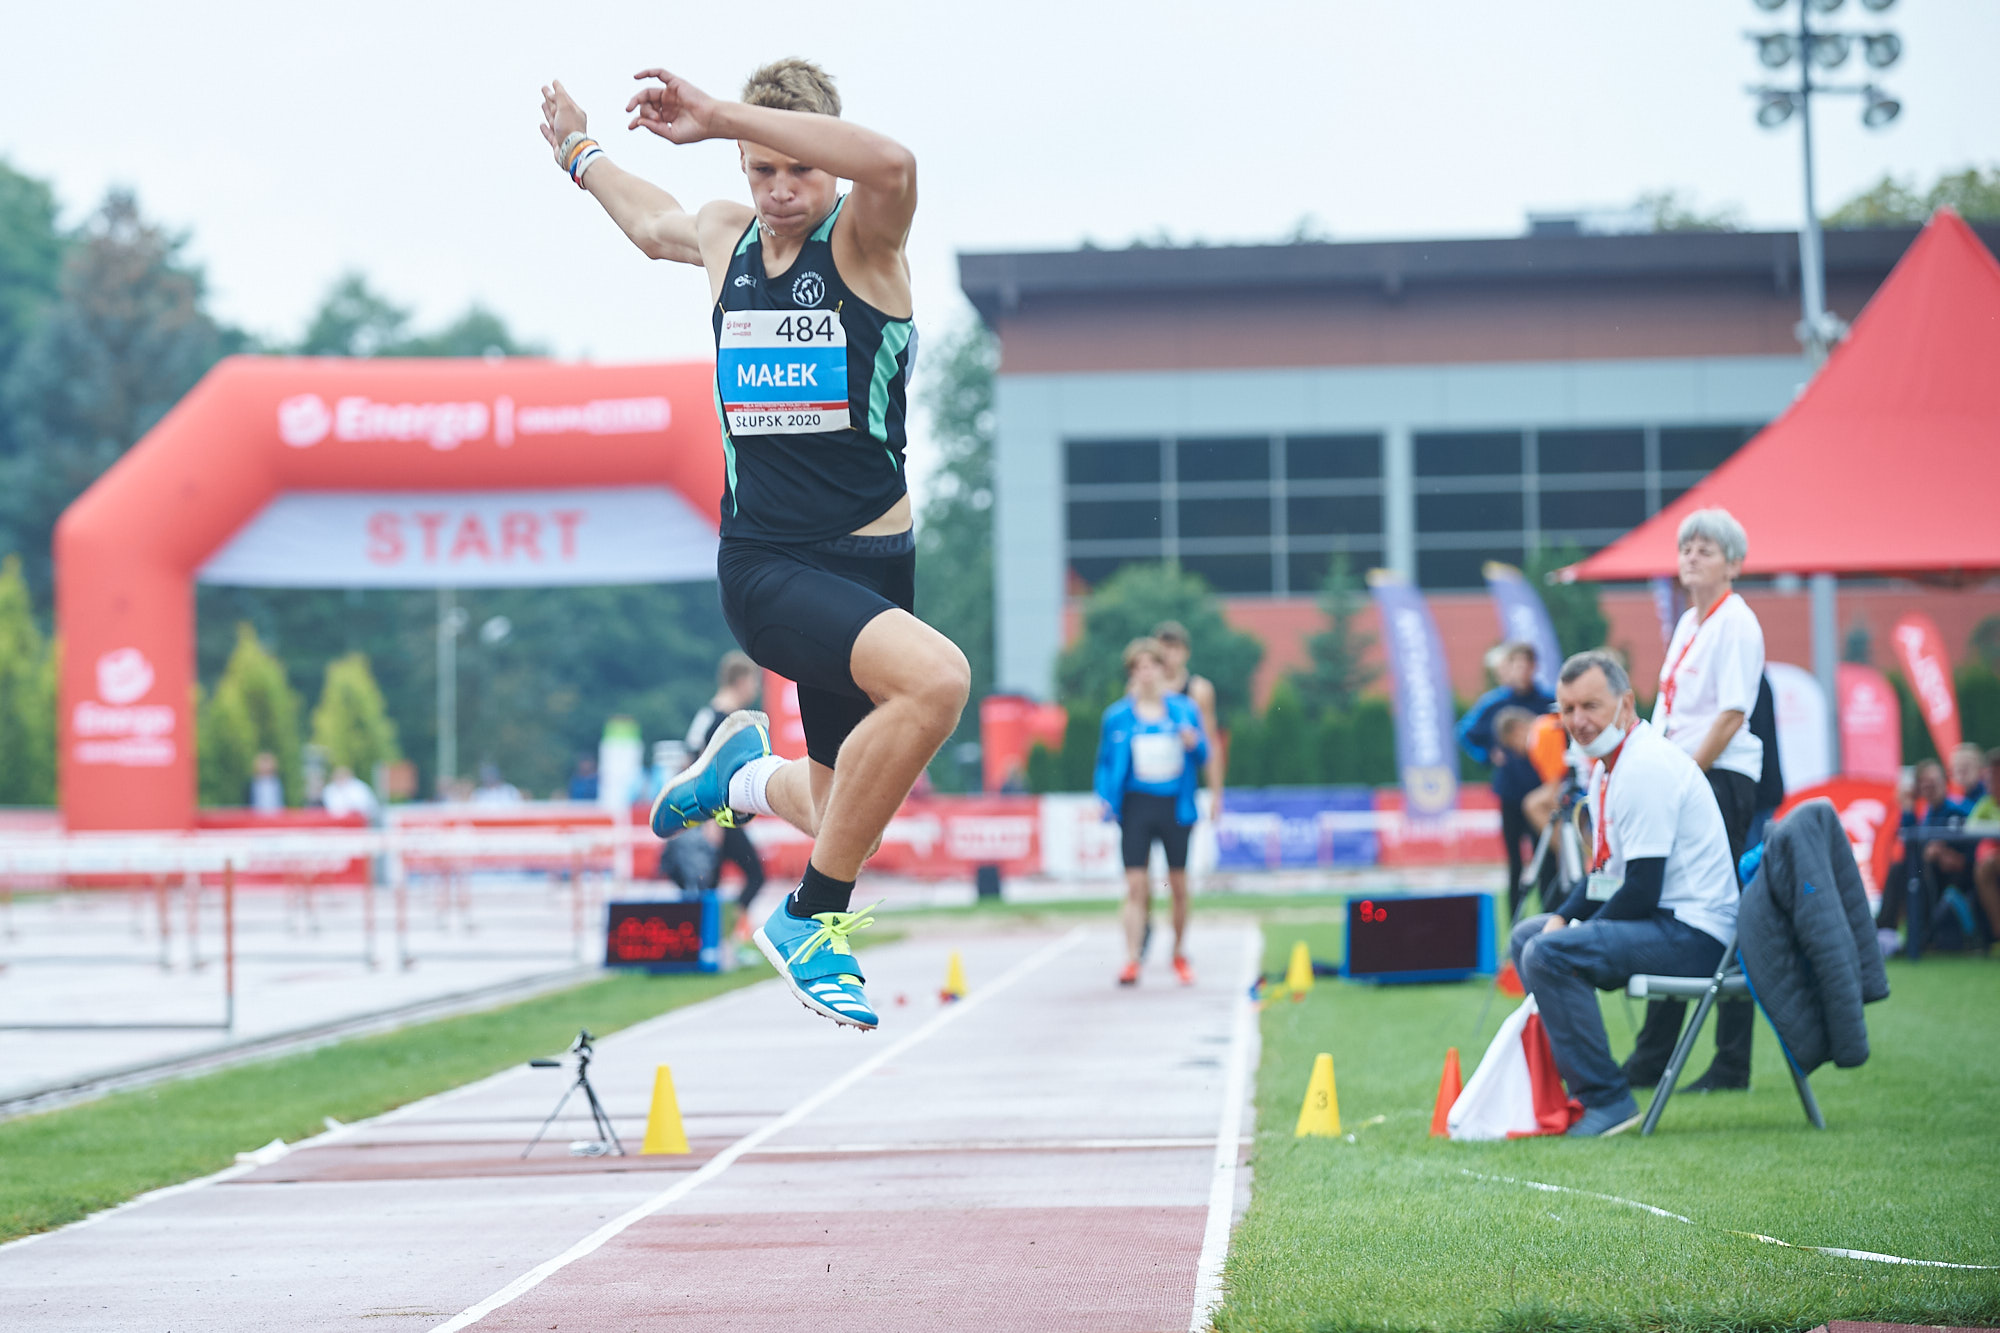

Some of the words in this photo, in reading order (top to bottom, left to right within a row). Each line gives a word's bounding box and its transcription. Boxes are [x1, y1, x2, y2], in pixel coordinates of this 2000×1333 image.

[776, 316, 835, 342] 484
[737, 363, 818, 387] MAŁEK
[336, 396, 489, 450] Energa
[736, 415, 783, 428] SŁUPSK
[788, 414, 821, 426] 2020
[365, 510, 586, 566] START
[1317, 1090, 1328, 1110] 3
